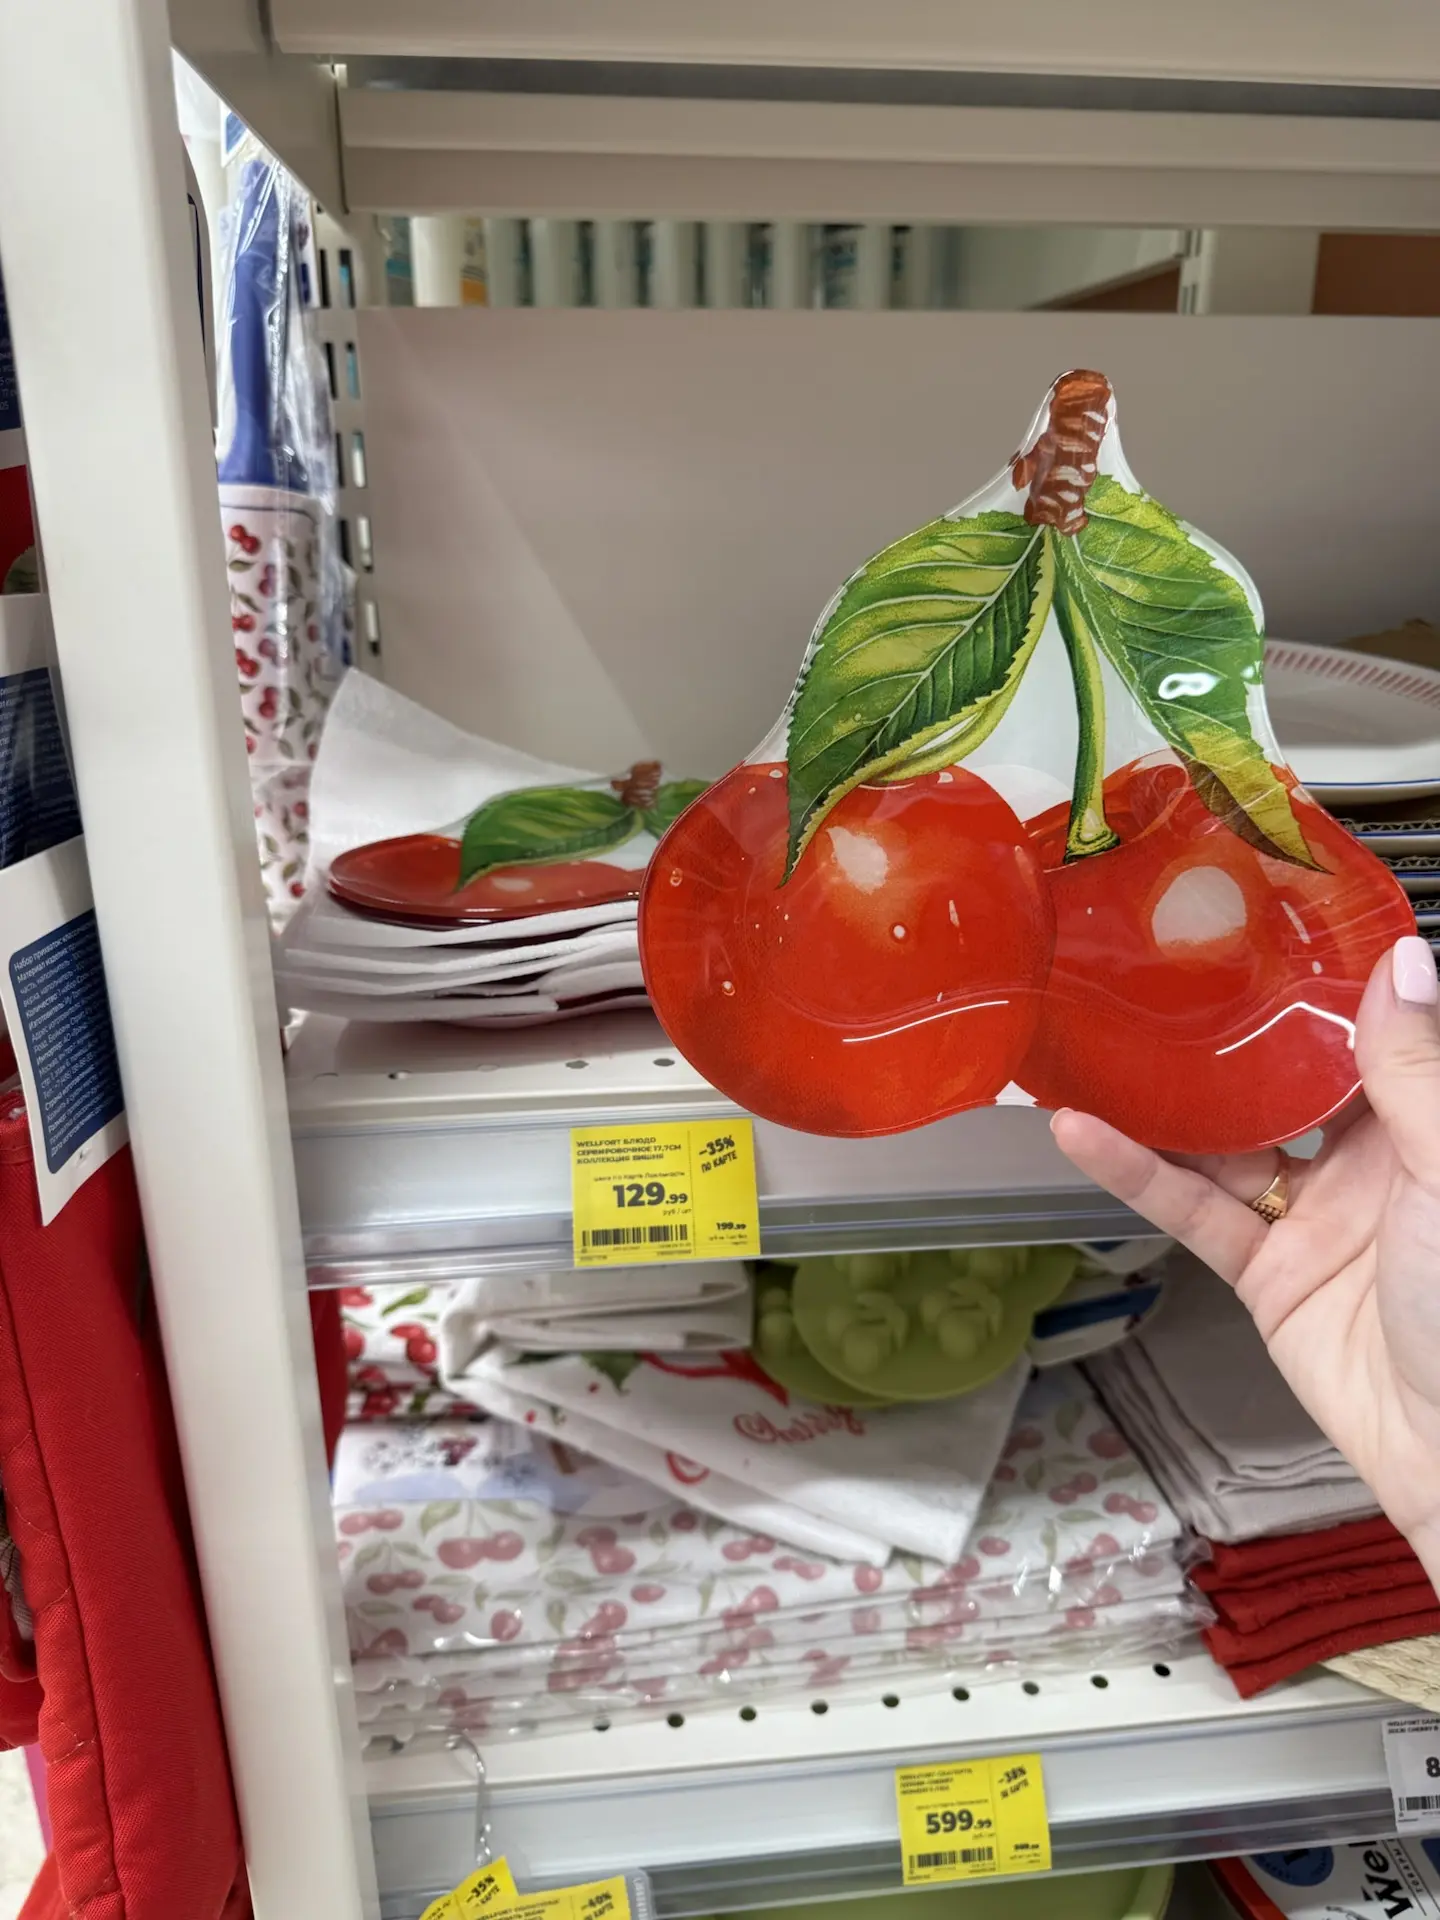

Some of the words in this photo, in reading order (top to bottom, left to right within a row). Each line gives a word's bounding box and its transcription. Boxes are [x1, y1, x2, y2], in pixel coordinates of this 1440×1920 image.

[576, 1139, 620, 1147] WELLFORT
[699, 1135, 735, 1156] -35%
[577, 1155, 630, 1165] КОЛЛЕКЦИЯ
[701, 1161, 713, 1173] ПО
[713, 1150, 738, 1168] КАРТЕ
[612, 1182, 689, 1208] 129.99
[926, 1809, 992, 1835] 599.99
[466, 1874, 496, 1903] -35%
[581, 1890, 613, 1911] -40%
